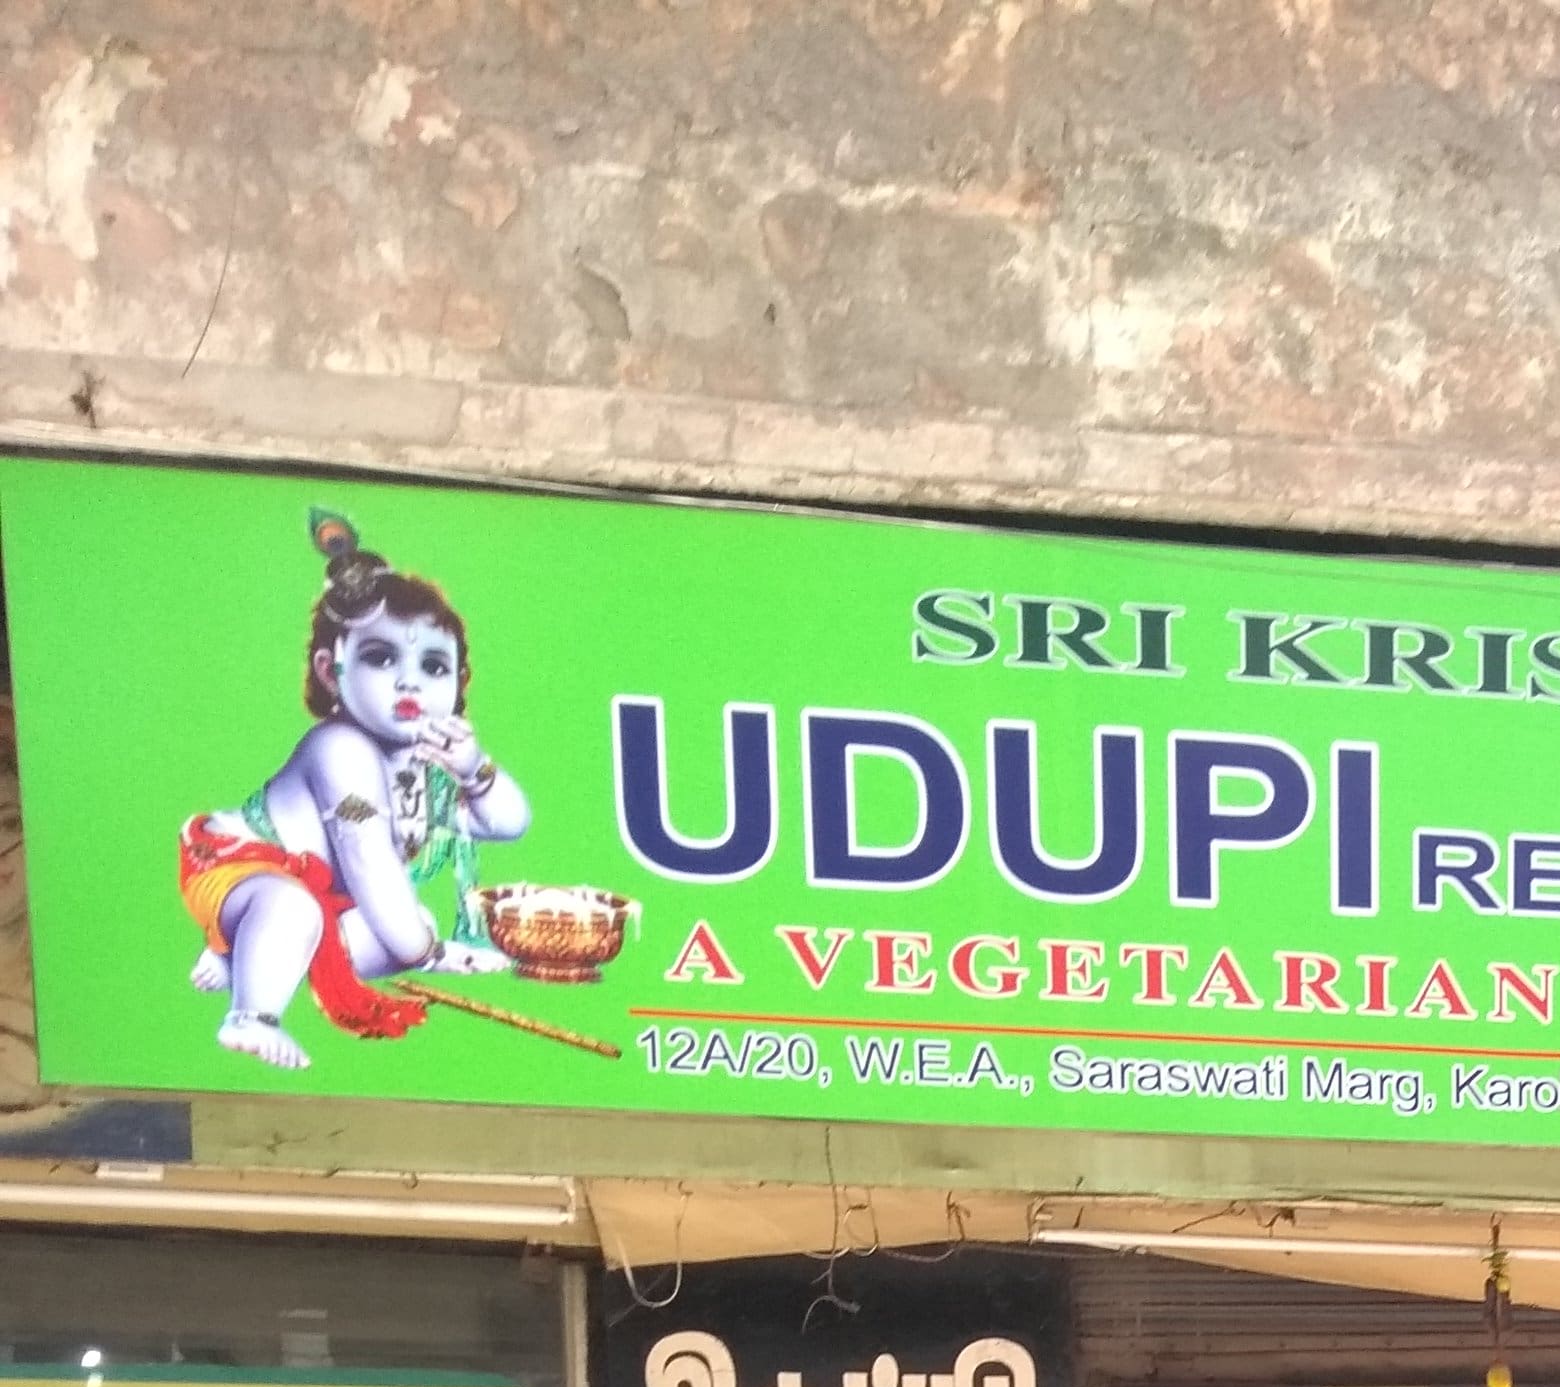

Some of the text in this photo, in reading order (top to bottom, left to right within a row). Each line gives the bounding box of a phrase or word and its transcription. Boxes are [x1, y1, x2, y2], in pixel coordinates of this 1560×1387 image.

[912, 588, 1186, 676] SRI
[611, 693, 1380, 918] UDUPI
[664, 920, 744, 984] A
[773, 925, 1560, 1026] VEGETARIAN
[636, 1025, 833, 1087] 12A/20,
[847, 1036, 1034, 1096] W.E.A.,
[1047, 1048, 1289, 1101] Saraswati
[1300, 1057, 1436, 1115] Marg,
